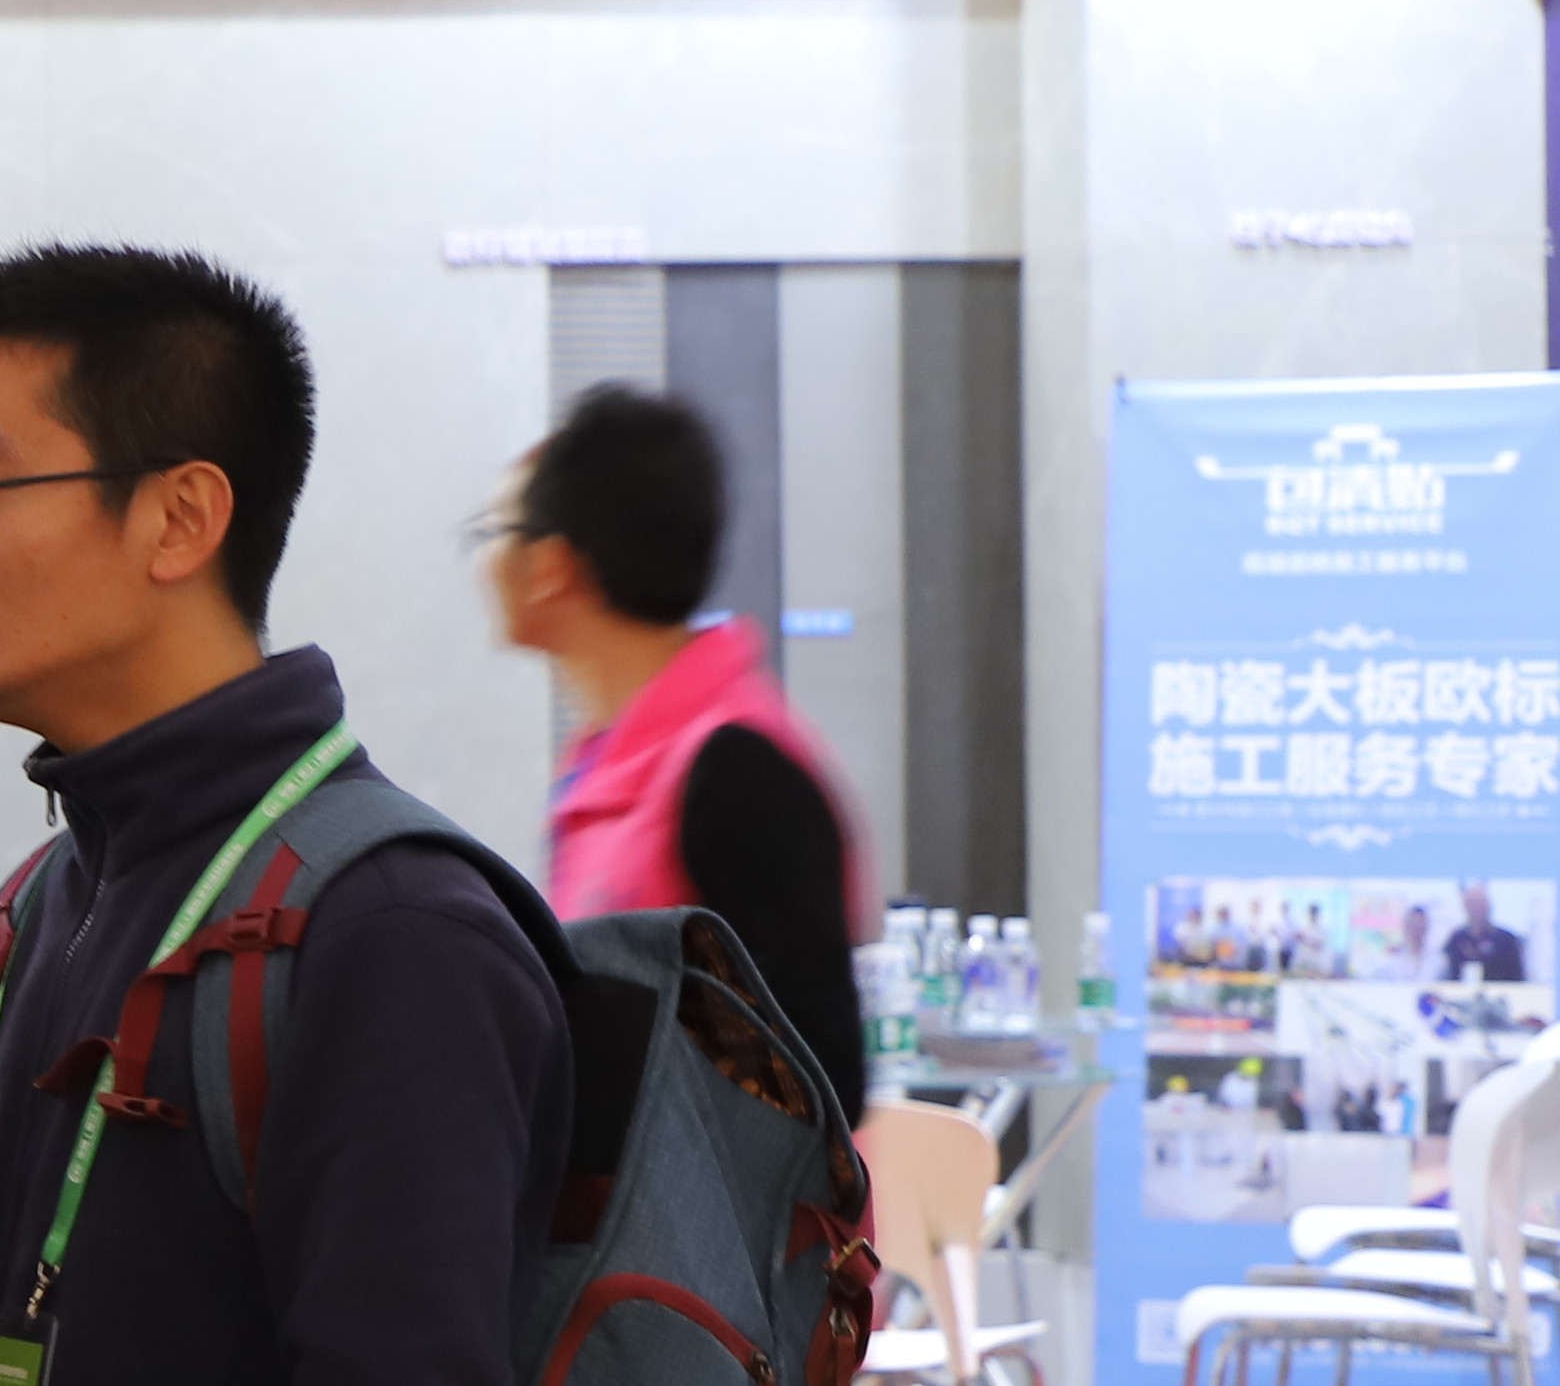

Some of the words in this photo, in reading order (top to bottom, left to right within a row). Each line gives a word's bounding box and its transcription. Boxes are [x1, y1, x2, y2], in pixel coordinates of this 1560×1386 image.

[1149, 658, 1560, 726] 陶瓷大板欧标
[1148, 730, 1560, 800] 施工服务专家
